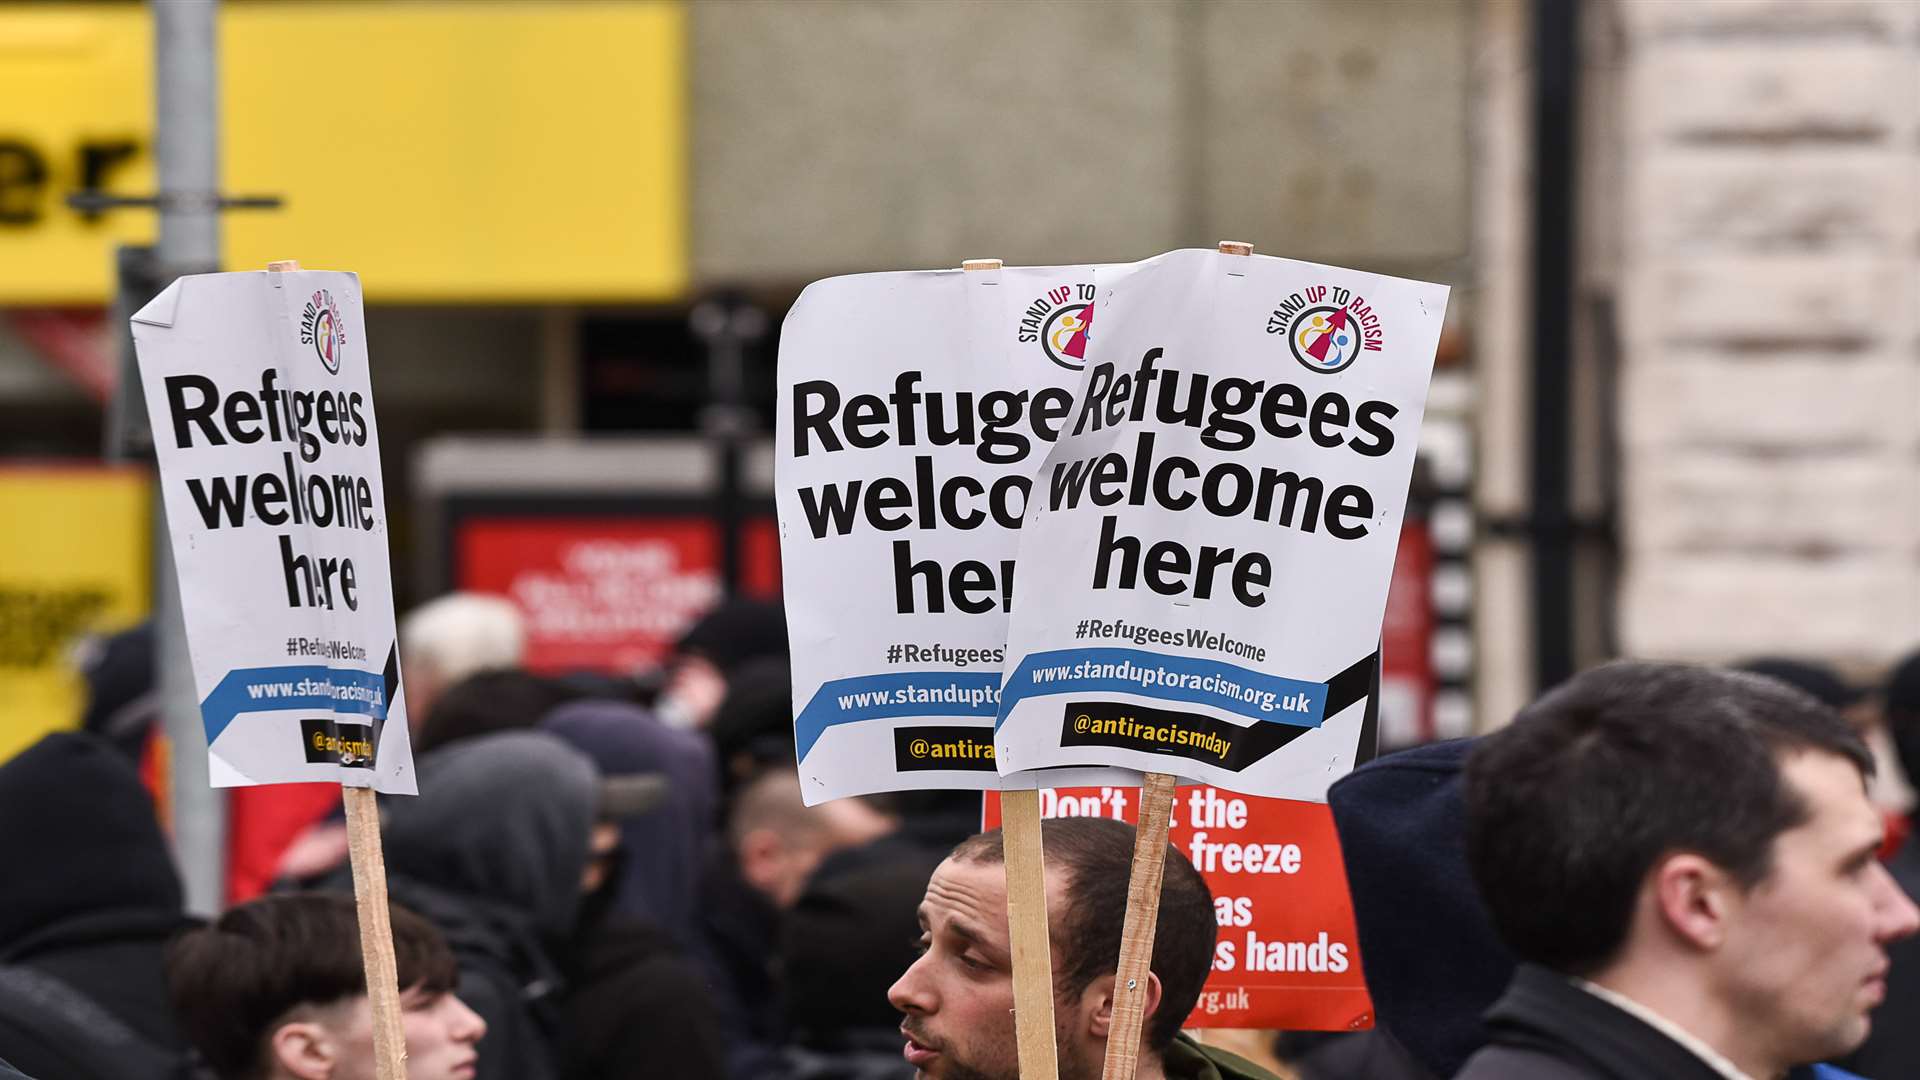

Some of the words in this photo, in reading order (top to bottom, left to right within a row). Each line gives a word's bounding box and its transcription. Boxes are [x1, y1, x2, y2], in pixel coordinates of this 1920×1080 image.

[300, 302, 317, 345] STAND
[1018, 298, 1052, 343] STAND
[1048, 285, 1071, 305] UP
[1076, 284, 1096, 301] TO
[1266, 293, 1306, 336] STAND
[1305, 285, 1327, 304] UP
[1332, 286, 1351, 306] TO
[1348, 296, 1383, 352] RACISM
[164, 368, 368, 463] Refugees
[793, 370, 1075, 465] Refuge
[1071, 347, 1400, 457] Refugees
[797, 455, 1034, 540] welco
[1049, 431, 1374, 541] welcome
[1092, 515, 1272, 608] here
[887, 643, 1007, 667] #Refugees
[1075, 619, 1267, 663] #RefugeesWelcome
[1032, 660, 1312, 714] www.standuptoracism.org.uk
[910, 738, 996, 759] @antira
[1074, 714, 1232, 760] @antiracismday
[1188, 787, 1249, 829] the
[1188, 832, 1302, 874] freeze
[1245, 931, 1349, 973] hands
[1196, 986, 1250, 1015] rg.uk
